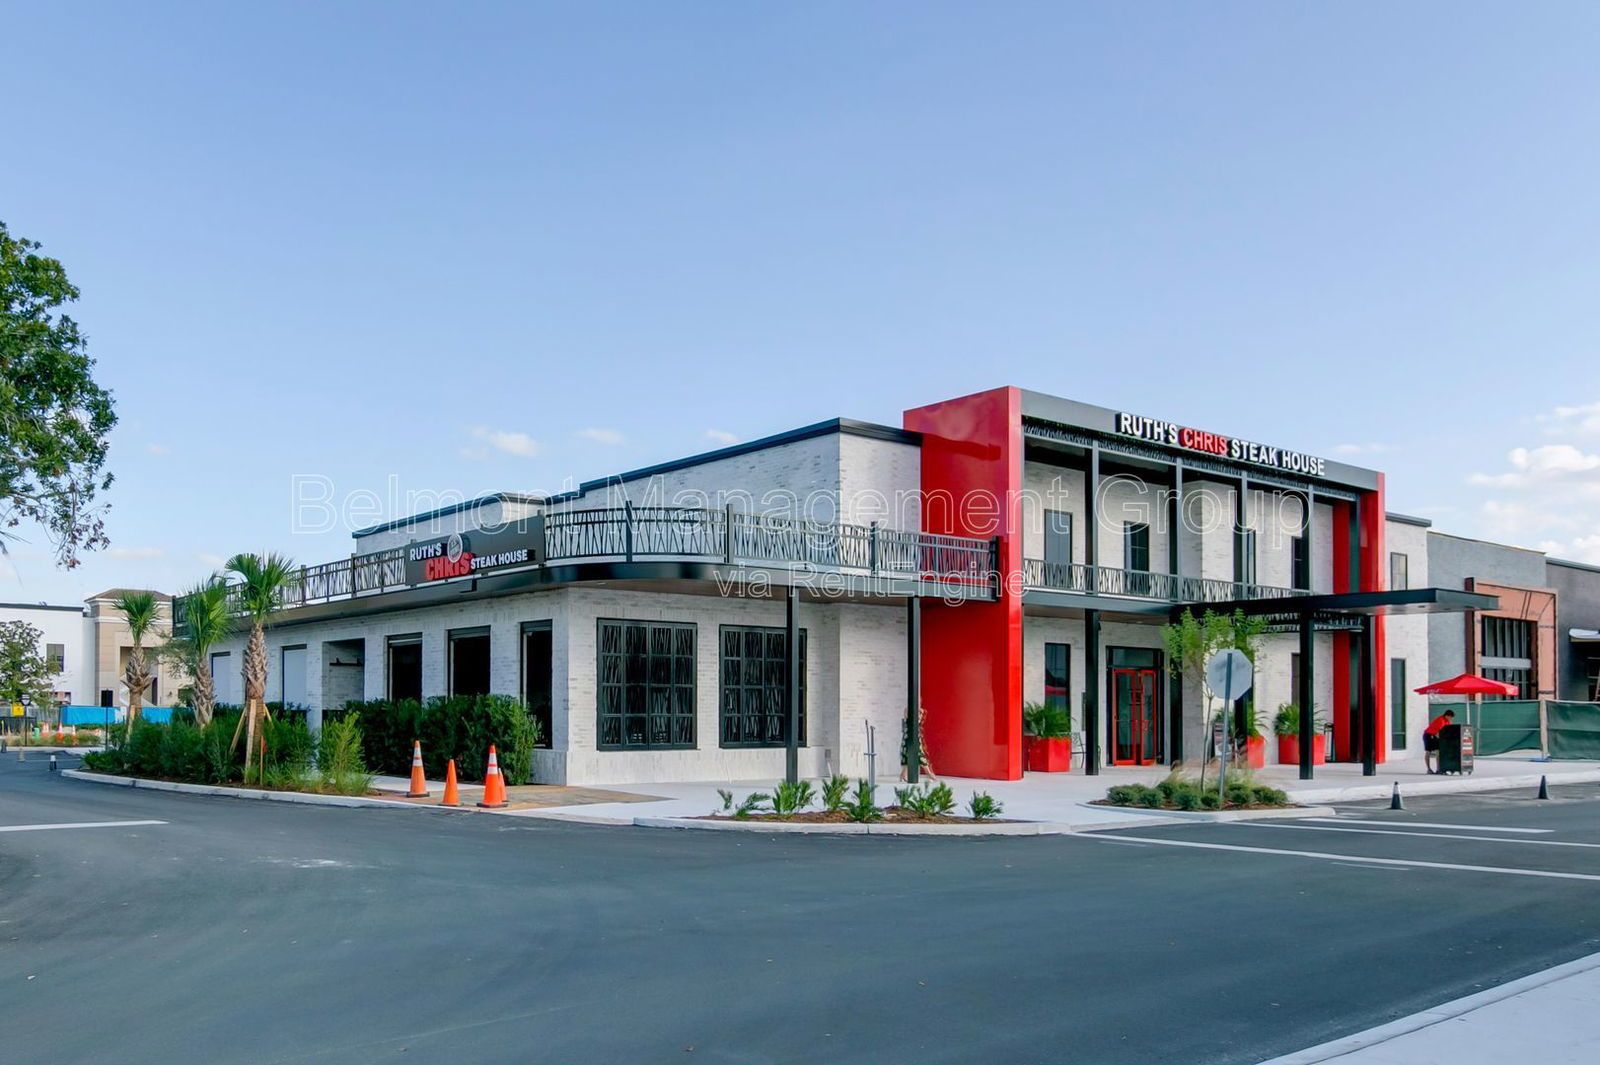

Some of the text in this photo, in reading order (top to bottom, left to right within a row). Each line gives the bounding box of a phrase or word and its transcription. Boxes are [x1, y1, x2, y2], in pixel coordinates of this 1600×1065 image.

[1120, 412, 1326, 476] RUTH'S CHRIS STEAK HOUSE
[409, 542, 443, 562] RUTH'S
[425, 549, 528, 580] CHRIS STEAK HOUSE
